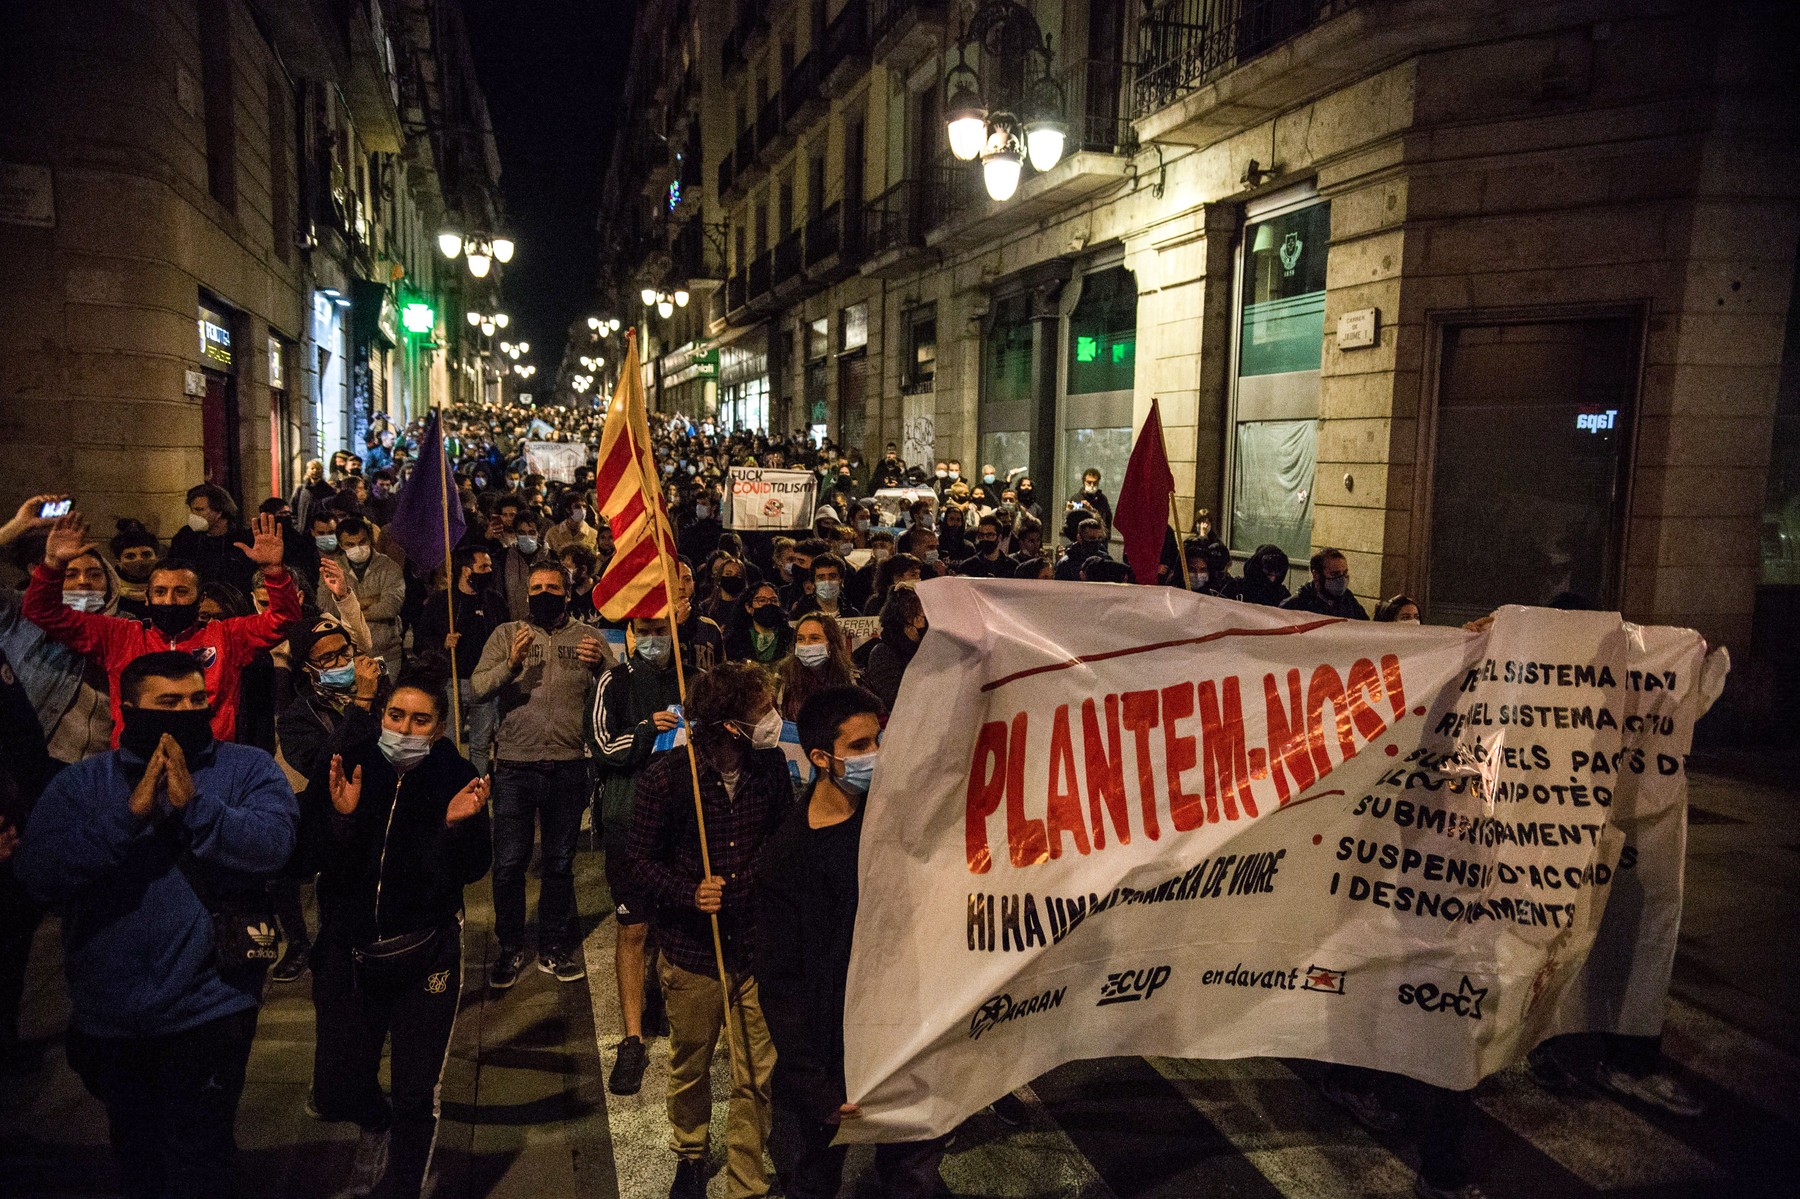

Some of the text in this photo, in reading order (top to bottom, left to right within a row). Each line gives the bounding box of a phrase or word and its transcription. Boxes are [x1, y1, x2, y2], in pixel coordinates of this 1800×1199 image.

[731, 470, 764, 481] FUCK
[1504, 660, 1617, 688] SISTEMA
[1499, 704, 1618, 731] SISTEMA
[965, 653, 1407, 875] PLANTEM-NOS!
[967, 892, 995, 952] HI
[1001, 893, 1046, 952] HA
[1200, 856, 1231, 899] DE
[1115, 965, 1172, 1001] CUP
[1201, 963, 1299, 991] endavant
